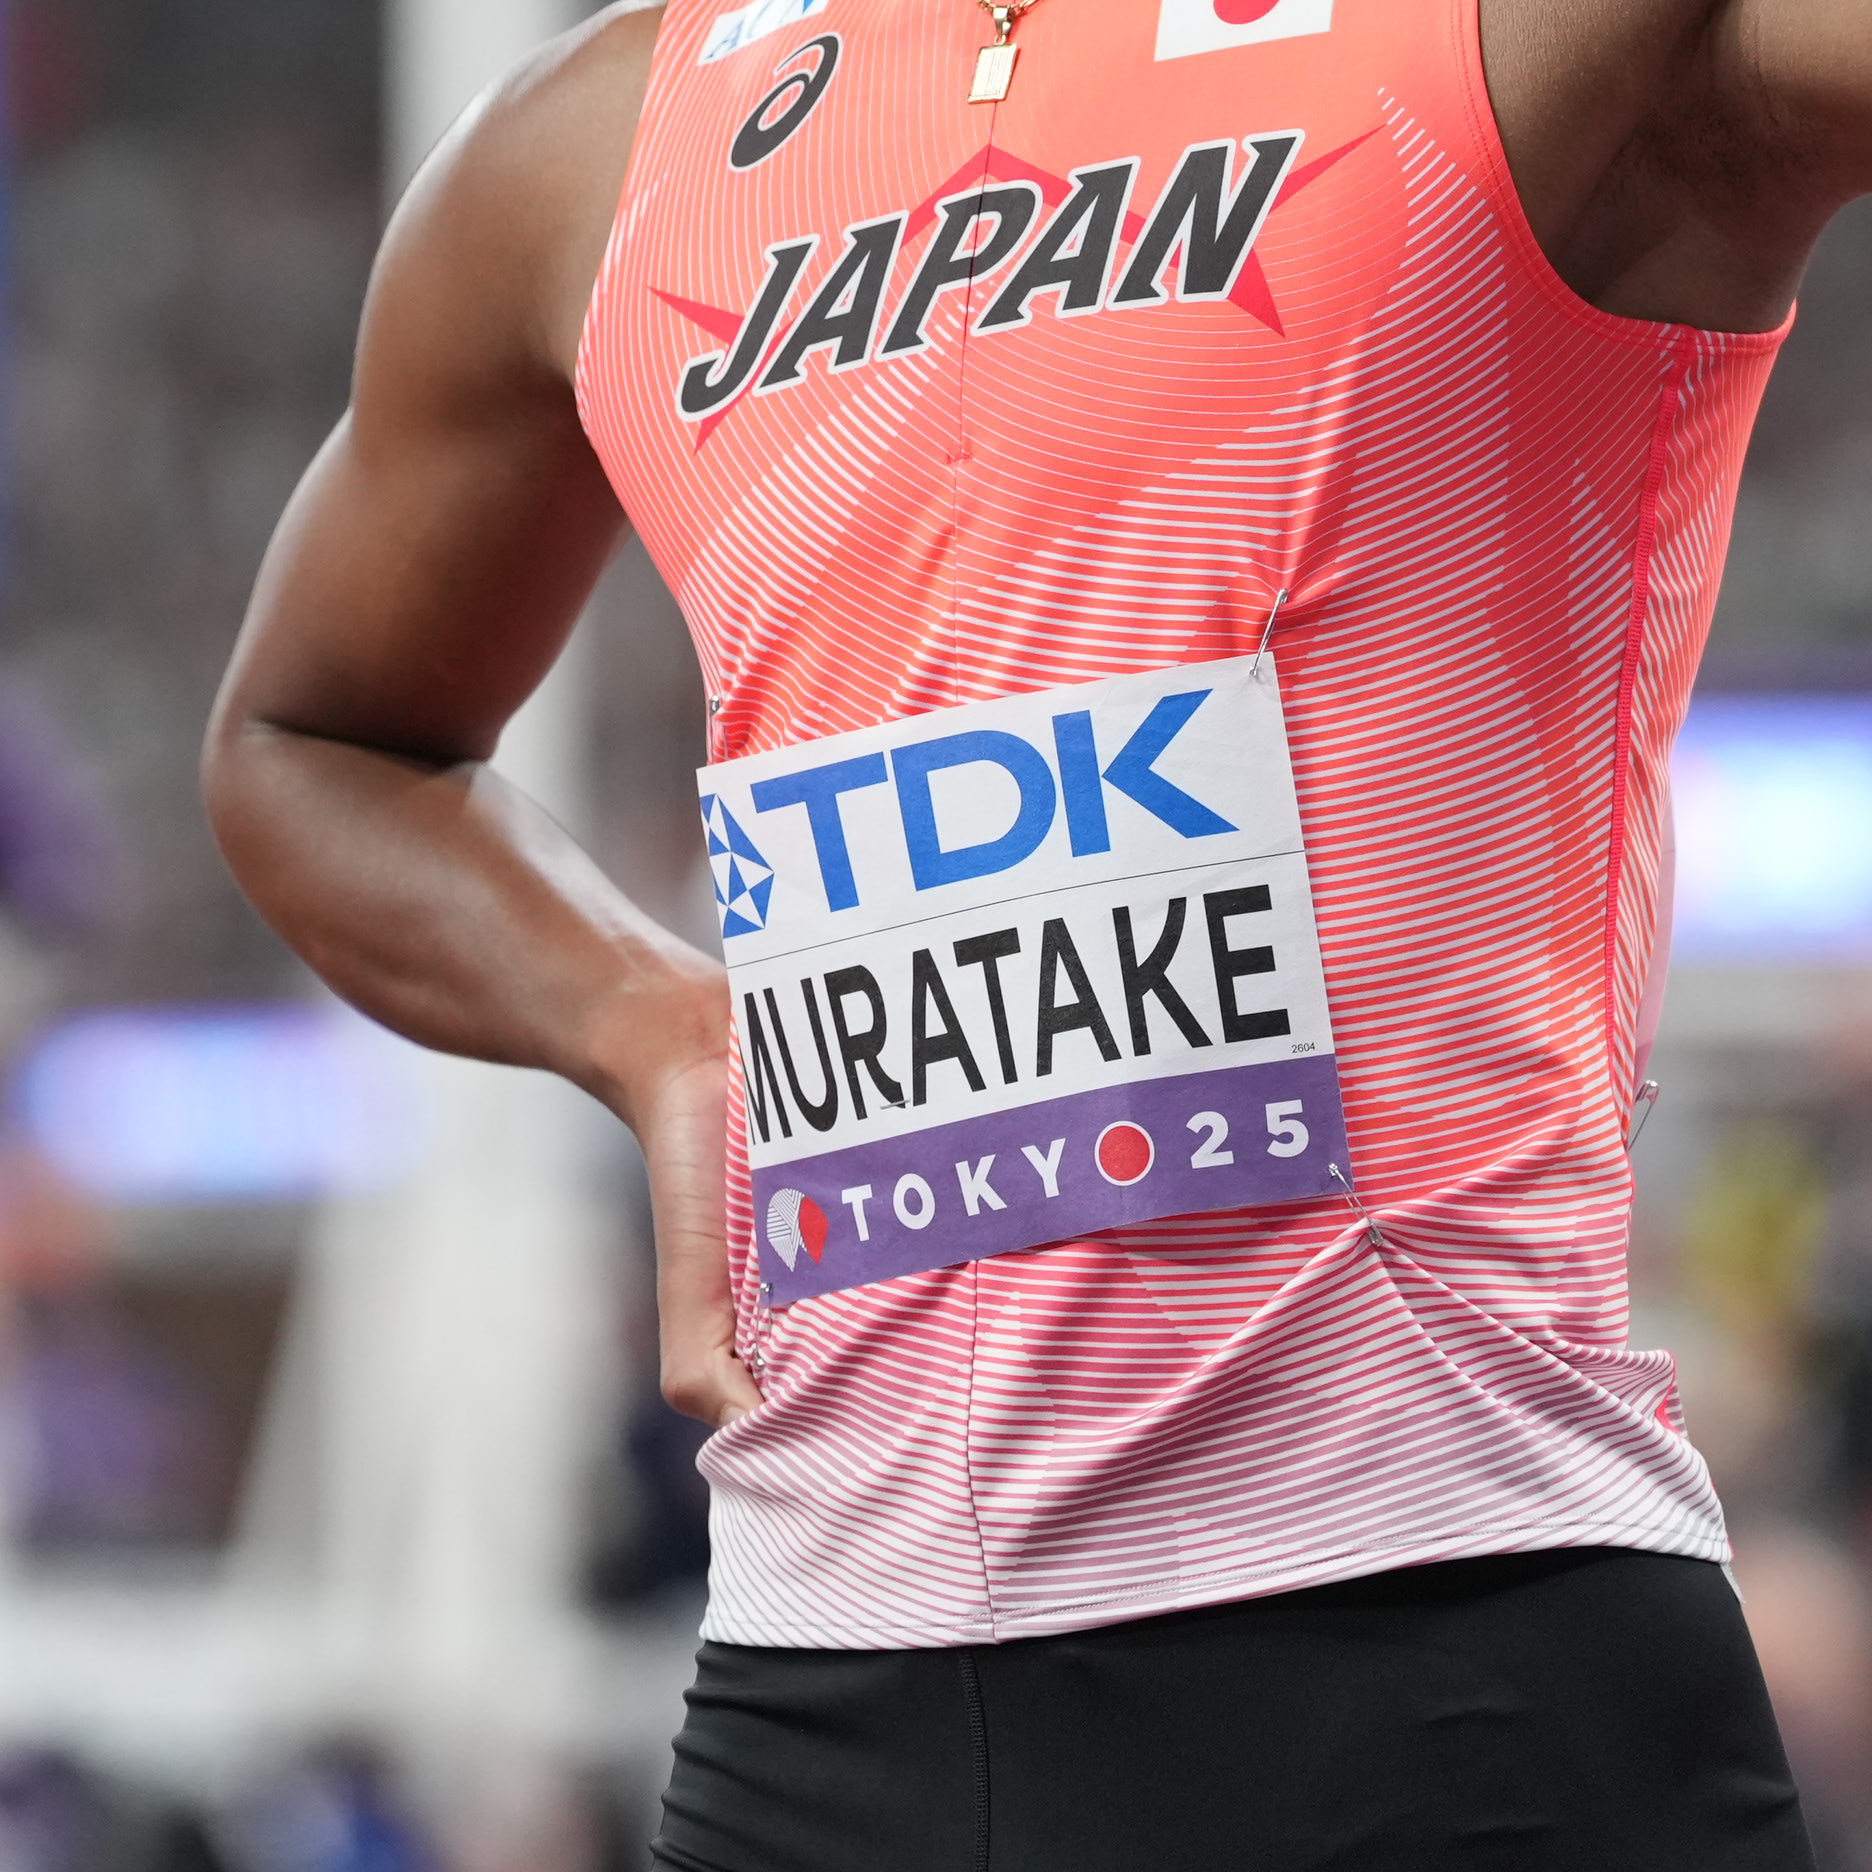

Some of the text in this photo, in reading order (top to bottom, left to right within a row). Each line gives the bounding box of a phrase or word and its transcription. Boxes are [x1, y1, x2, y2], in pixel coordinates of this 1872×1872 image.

[676, 130, 1304, 419] JAPAN
[750, 688, 1240, 913] TDK
[737, 884, 1290, 1145] MURATAKE
[1291, 1042, 1316, 1054] 2604
